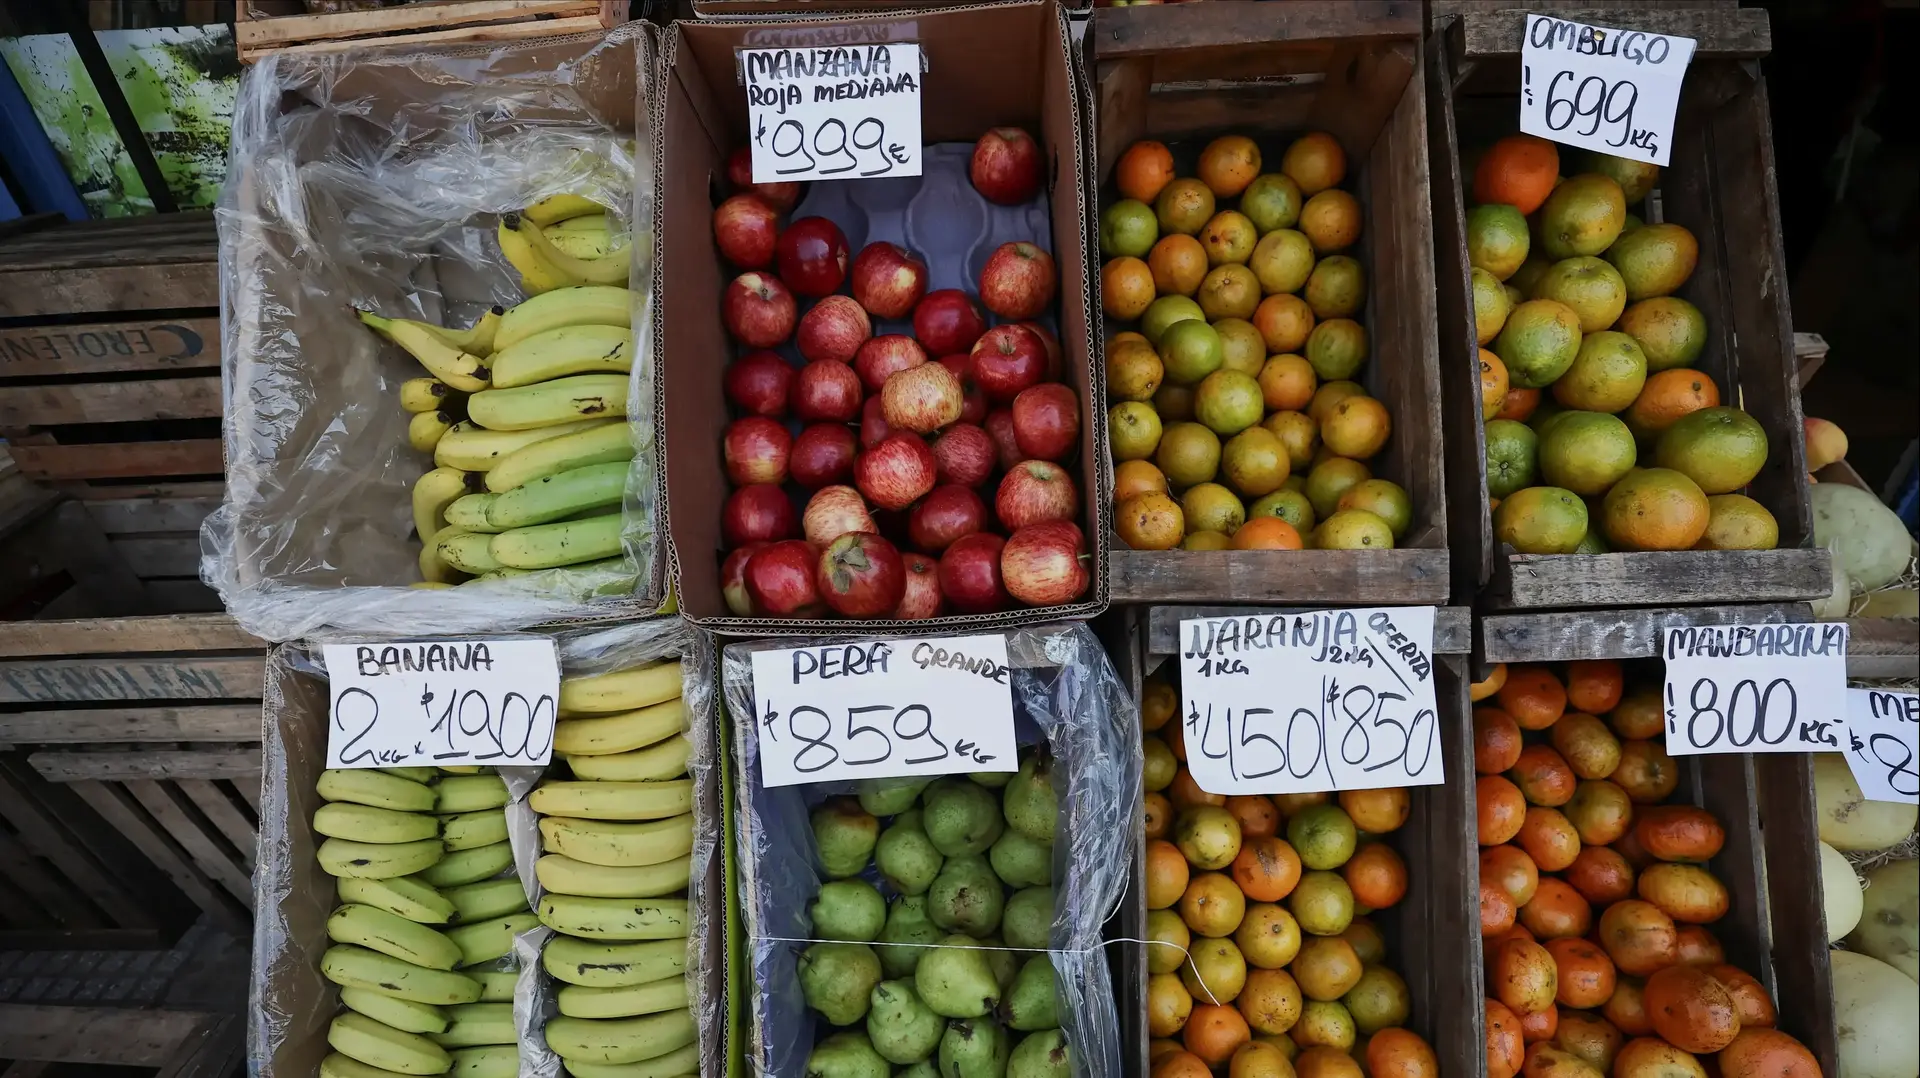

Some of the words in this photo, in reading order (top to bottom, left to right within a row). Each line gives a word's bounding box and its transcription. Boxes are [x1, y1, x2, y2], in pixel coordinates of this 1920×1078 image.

[1530, 17, 1670, 65] OMBLIGO
[747, 46, 892, 83] MANZANA
[749, 83, 802, 114] ROJA
[814, 72, 918, 102] MEDIANA
[1185, 611, 1358, 663] NARANJA
[1367, 612, 1431, 682] OFERTA
[1669, 625, 1844, 660] MANDARINA
[357, 643, 494, 676] BANANA
[792, 642, 889, 684] PERA
[912, 643, 1010, 685] GRANDE
